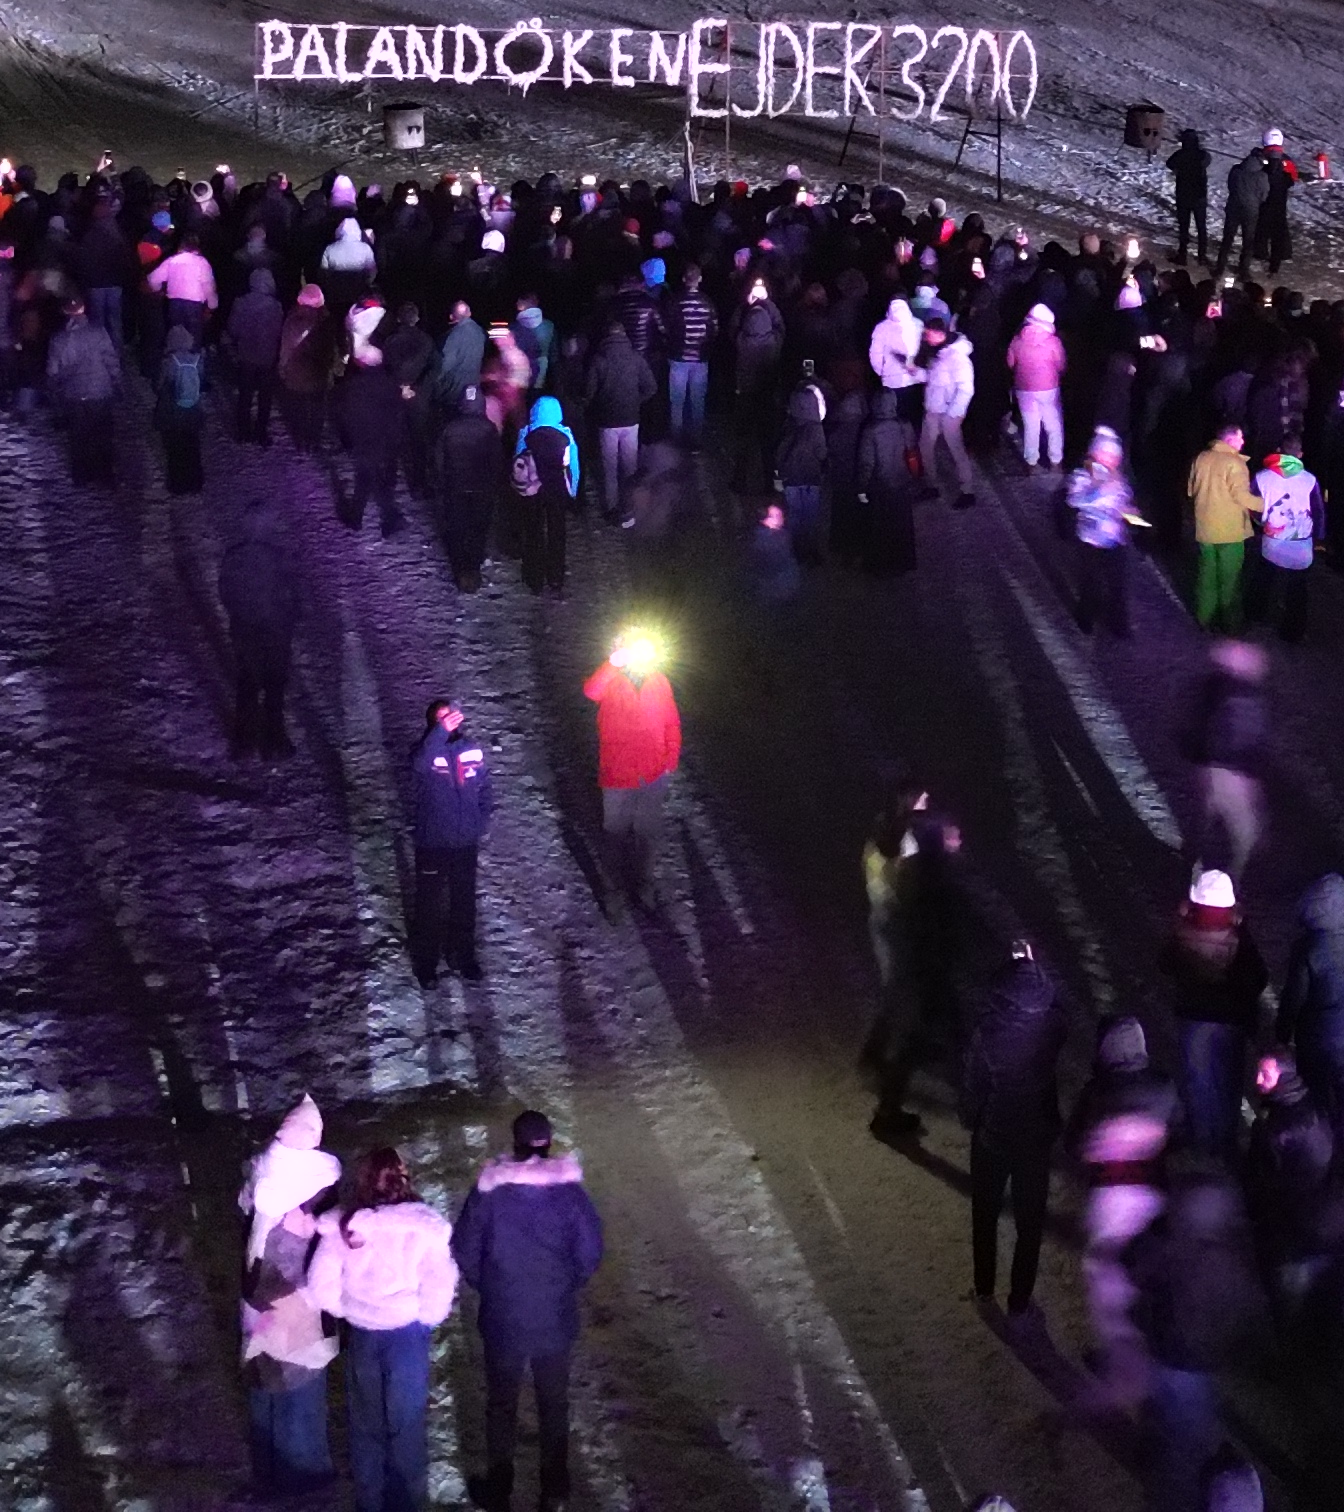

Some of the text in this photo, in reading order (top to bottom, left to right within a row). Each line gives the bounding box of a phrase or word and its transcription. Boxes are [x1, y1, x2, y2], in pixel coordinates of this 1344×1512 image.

[262, 17, 1039, 123] PALANDÖKEN EJDER 3200
